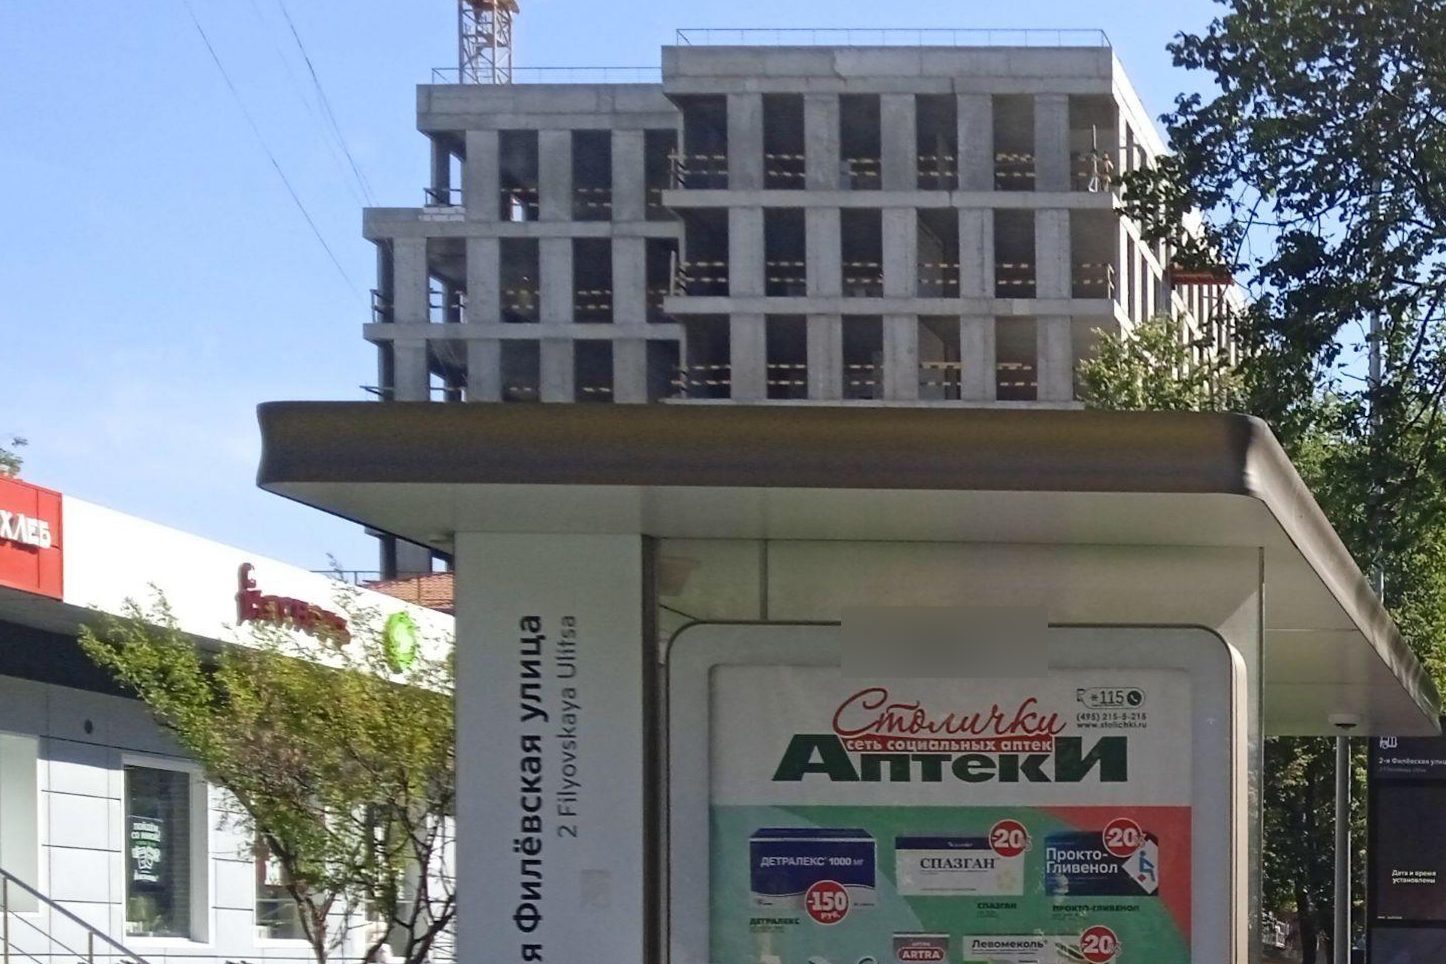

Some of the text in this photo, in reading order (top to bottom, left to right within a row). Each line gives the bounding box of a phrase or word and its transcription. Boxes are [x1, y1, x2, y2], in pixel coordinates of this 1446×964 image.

[0, 509, 51, 549] ХЛЕБ
[520, 615, 549, 723] улица
[832, 687, 1066, 737] Столички
[1077, 712, 1099, 721] (495)
[556, 615, 581, 838] 2 Filyovskaya Ulitsa
[1077, 721, 1147, 729] www.stolichki.ru
[846, 738, 1052, 753] сеть социальных аптек
[513, 735, 543, 933] Филёвская
[829, 857, 851, 866] 1000
[1046, 847, 1108, 862] Прокто-
[920, 858, 995, 869] СПАЗГАН
[1046, 861, 1118, 873] Гливенол
[807, 891, 848, 911] -150
[972, 939, 1044, 949] Левомеколь
[902, 950, 941, 959] ARTRA
